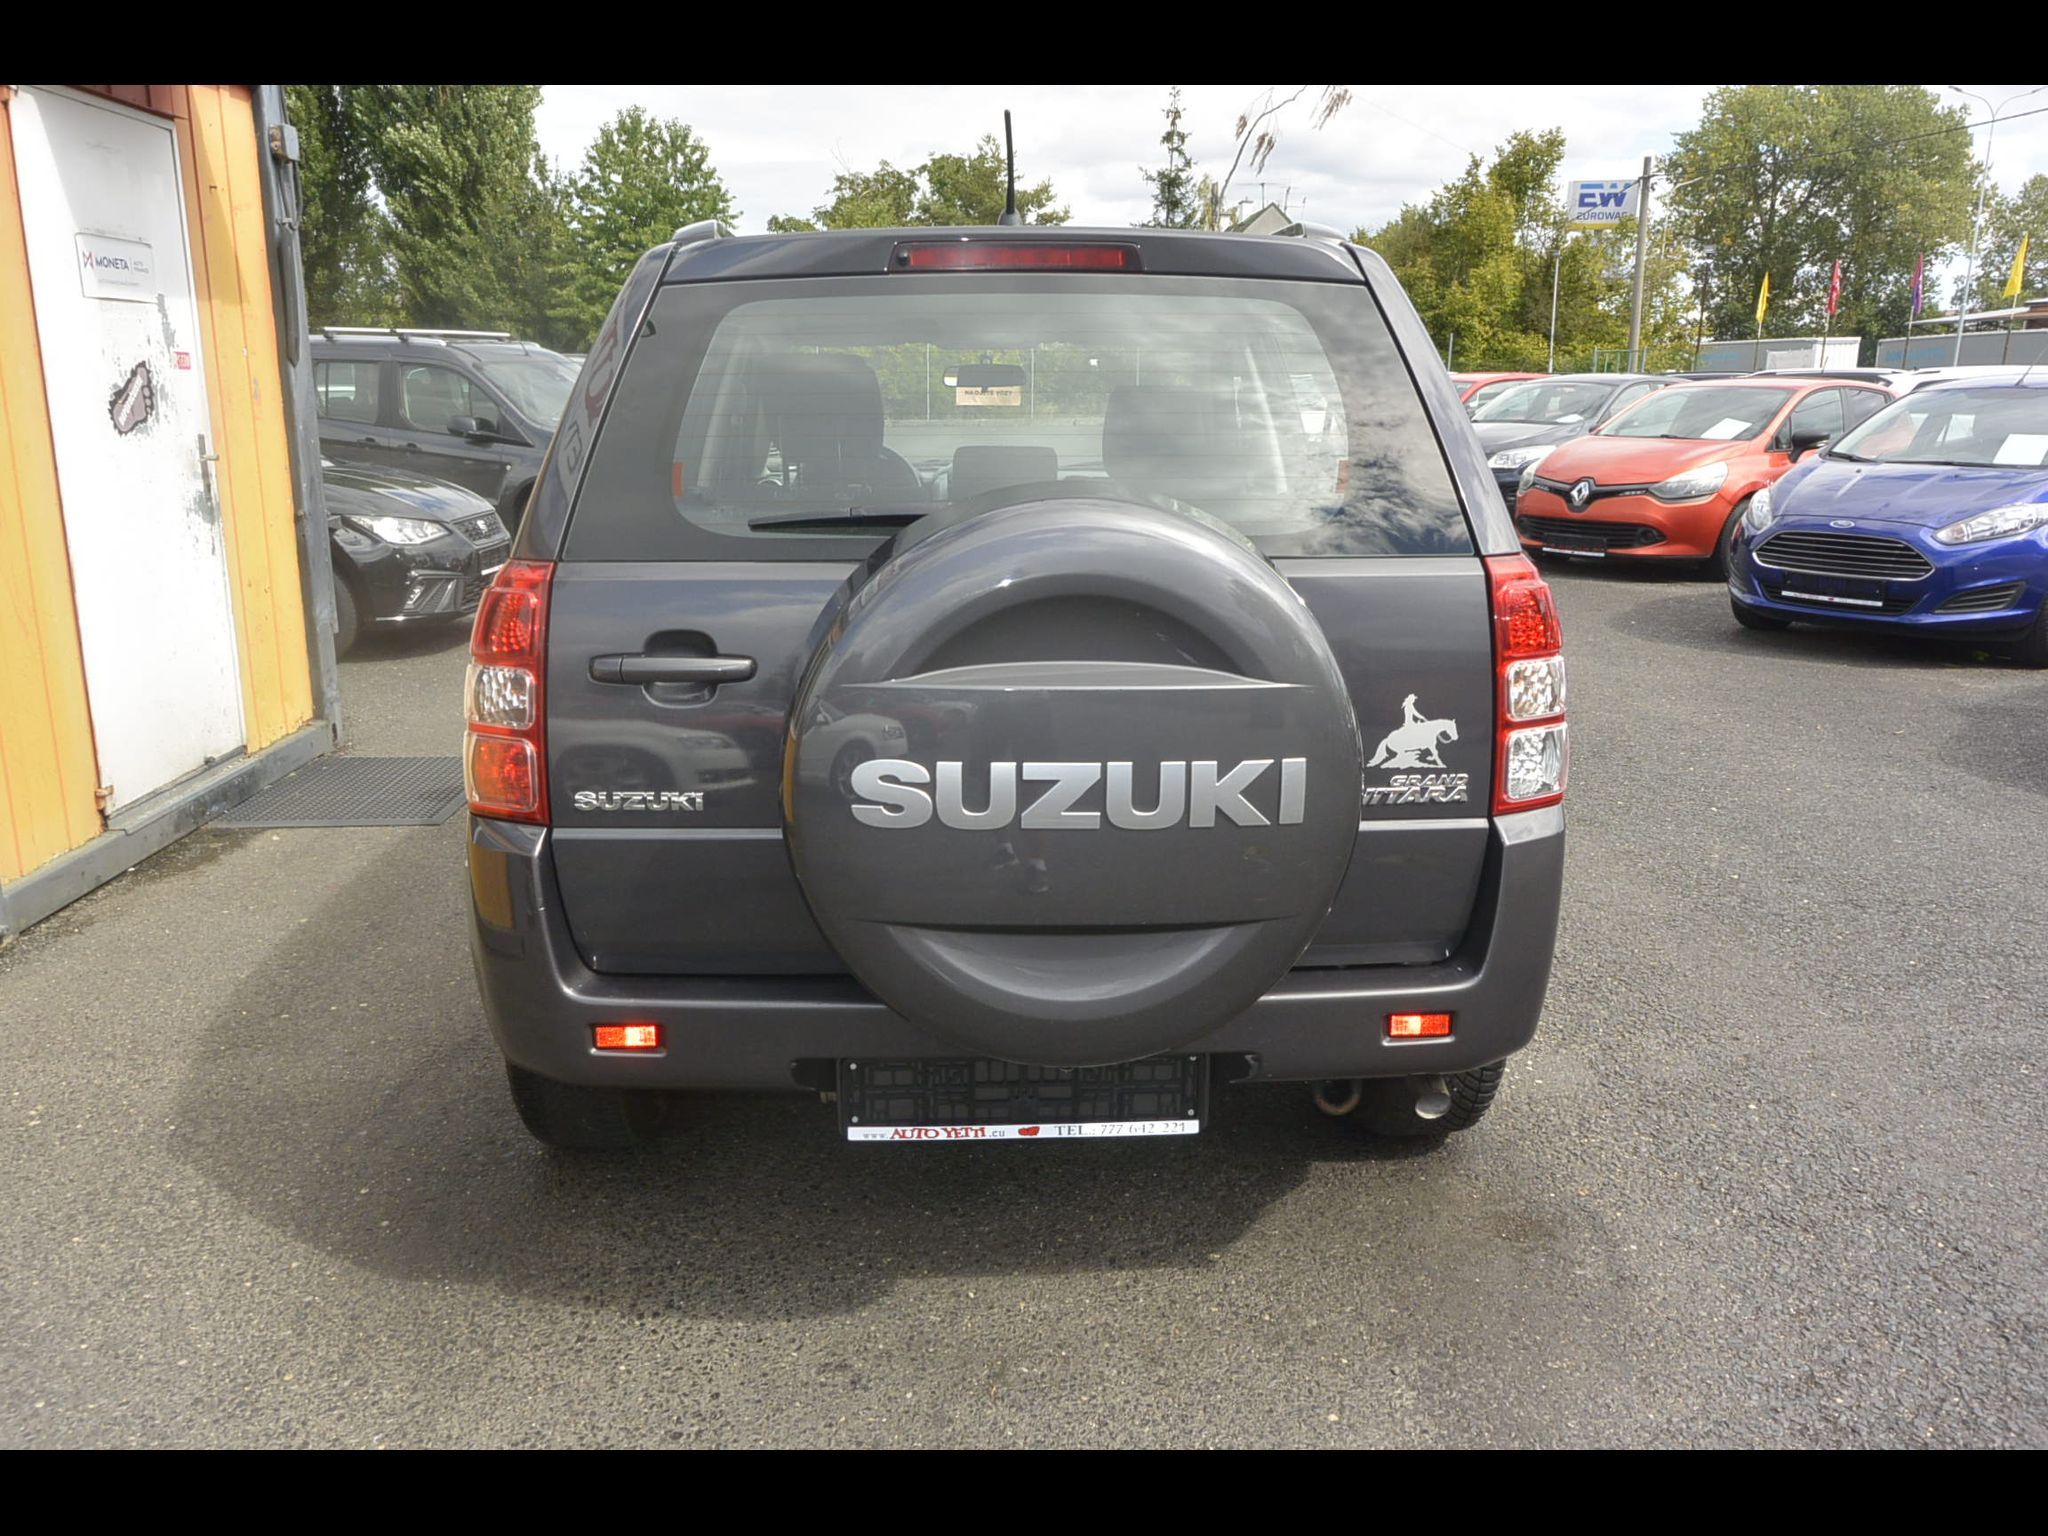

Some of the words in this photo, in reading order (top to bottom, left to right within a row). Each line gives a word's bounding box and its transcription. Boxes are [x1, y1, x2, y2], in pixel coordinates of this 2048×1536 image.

[1578, 192, 1627, 208] EW
[95, 256, 130, 271] MONETA
[1390, 773, 1469, 787] GRAND
[573, 790, 705, 812] SUZUKI
[850, 757, 1308, 831] SUZUKI
